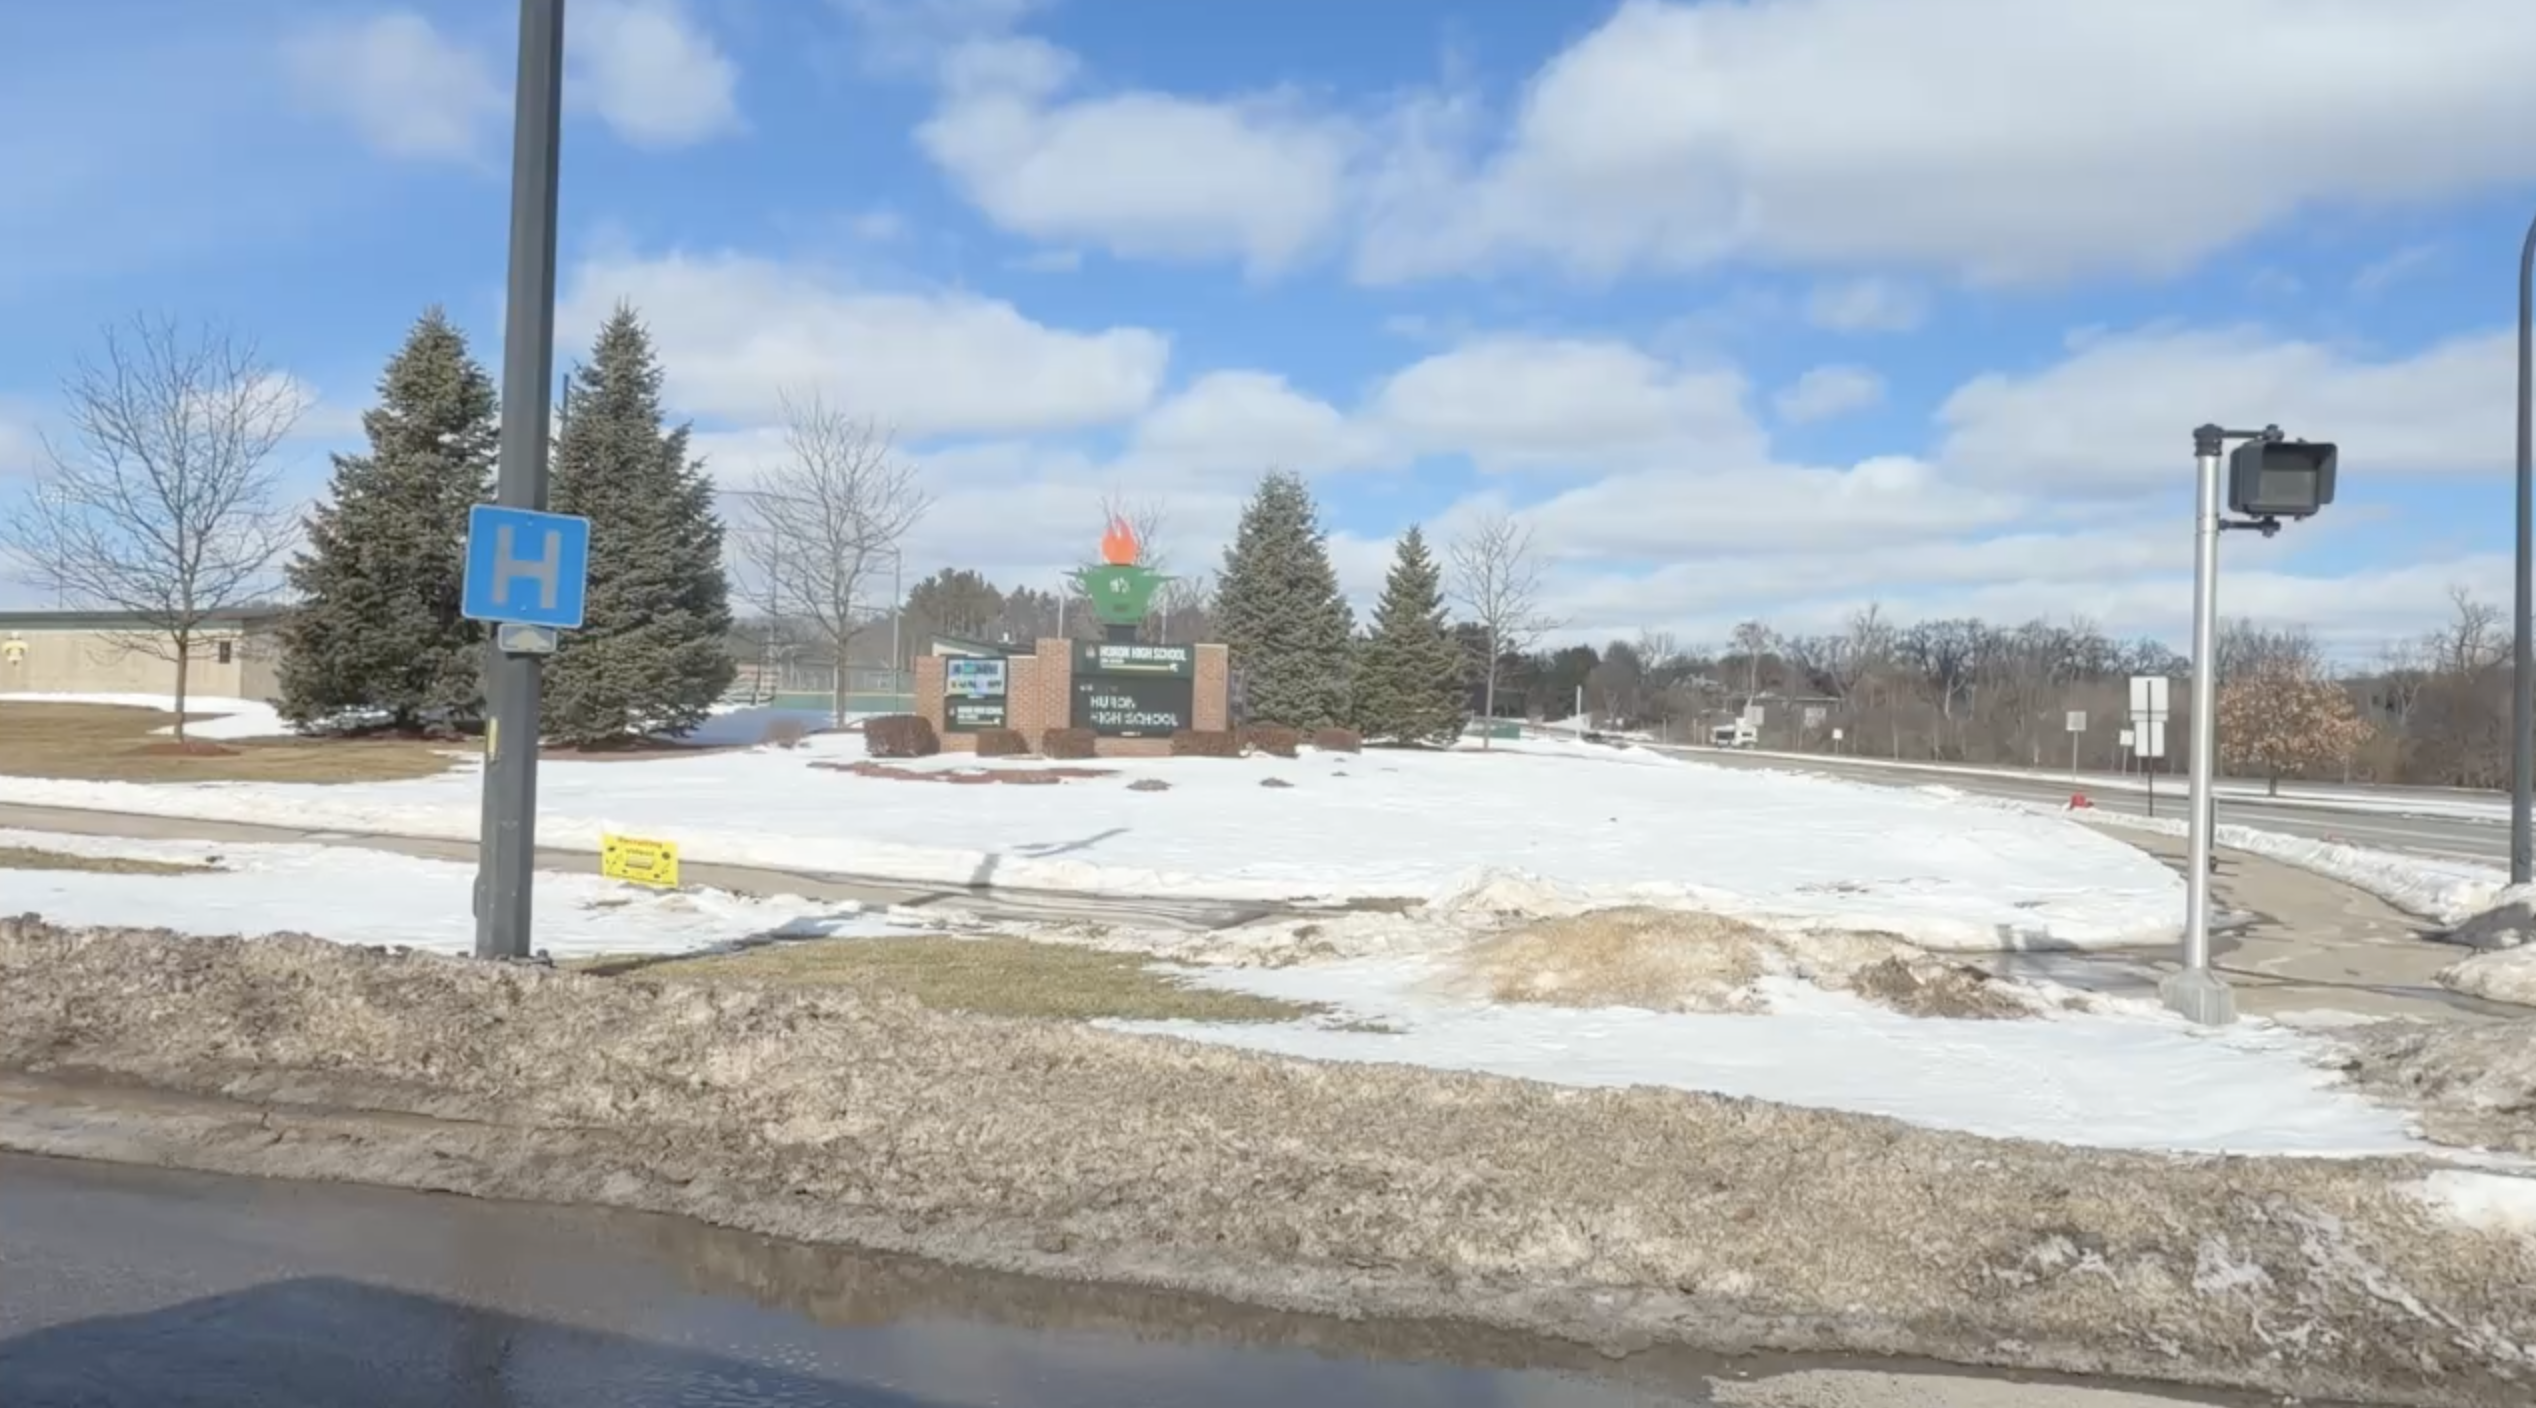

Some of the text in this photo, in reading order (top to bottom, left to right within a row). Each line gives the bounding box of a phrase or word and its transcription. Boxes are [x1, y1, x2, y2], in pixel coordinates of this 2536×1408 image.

[492, 525, 561, 609] H
[1132, 646, 1152, 659] HIGH
[1154, 648, 1187, 660] SCHOOL
[1125, 712, 1178, 726] SCHOOL
